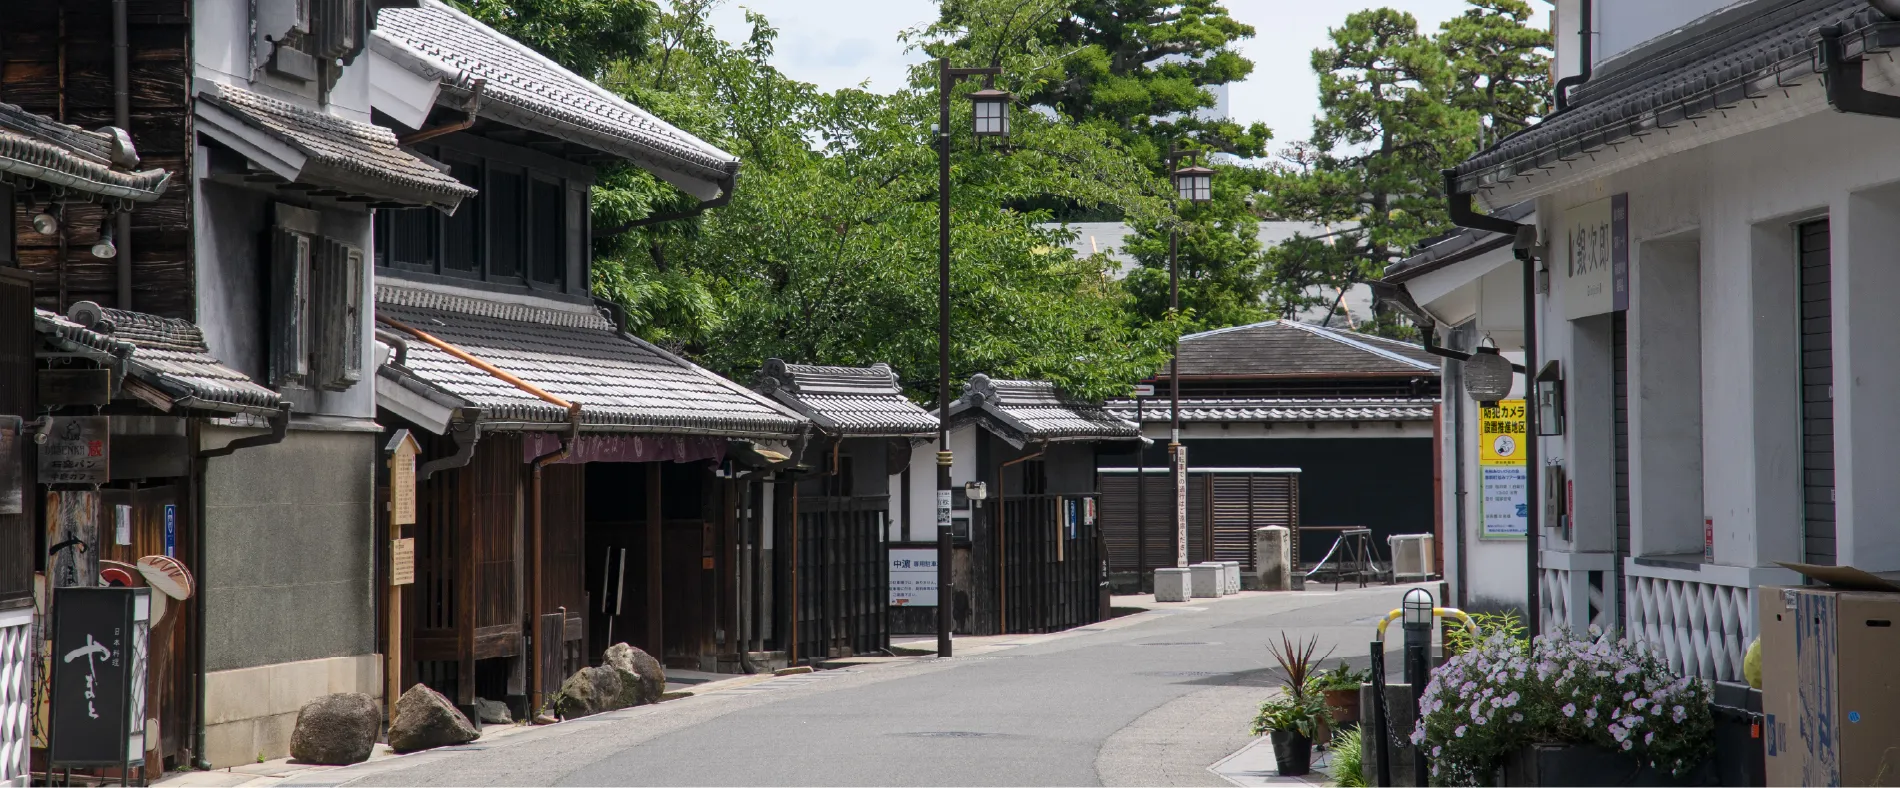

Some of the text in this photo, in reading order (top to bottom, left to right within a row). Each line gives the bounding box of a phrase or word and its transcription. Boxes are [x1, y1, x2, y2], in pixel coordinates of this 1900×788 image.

[1484, 406, 1524, 418] 防犯カメラ
[1484, 421, 1526, 434] 設置推進地区
[112, 627, 120, 667] 日本料理
[64, 633, 111, 719] やまと
